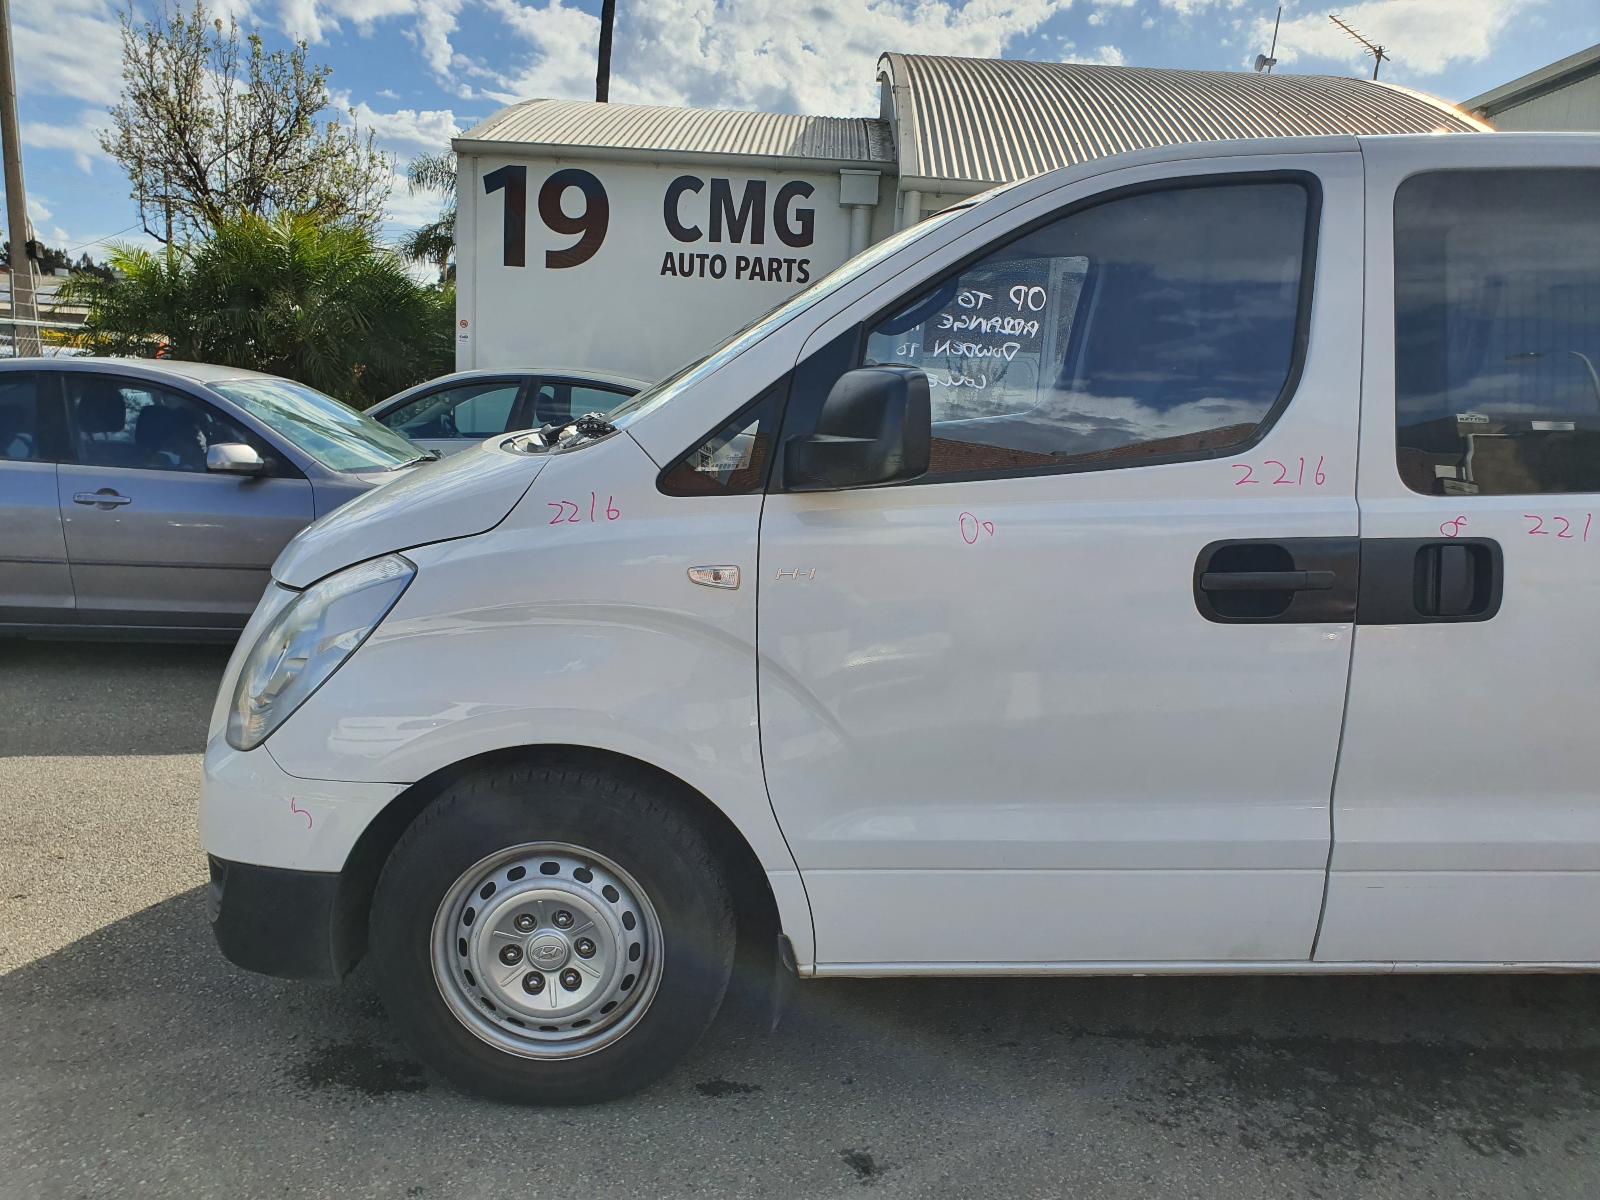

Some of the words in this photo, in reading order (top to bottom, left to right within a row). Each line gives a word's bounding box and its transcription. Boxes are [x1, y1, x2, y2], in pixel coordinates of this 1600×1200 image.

[483, 165, 610, 269] 19
[663, 175, 816, 248] CMG
[660, 251, 728, 280] AUTO
[734, 255, 811, 284] PARTS
[1232, 456, 1326, 486] 2216
[547, 491, 621, 525] 2216
